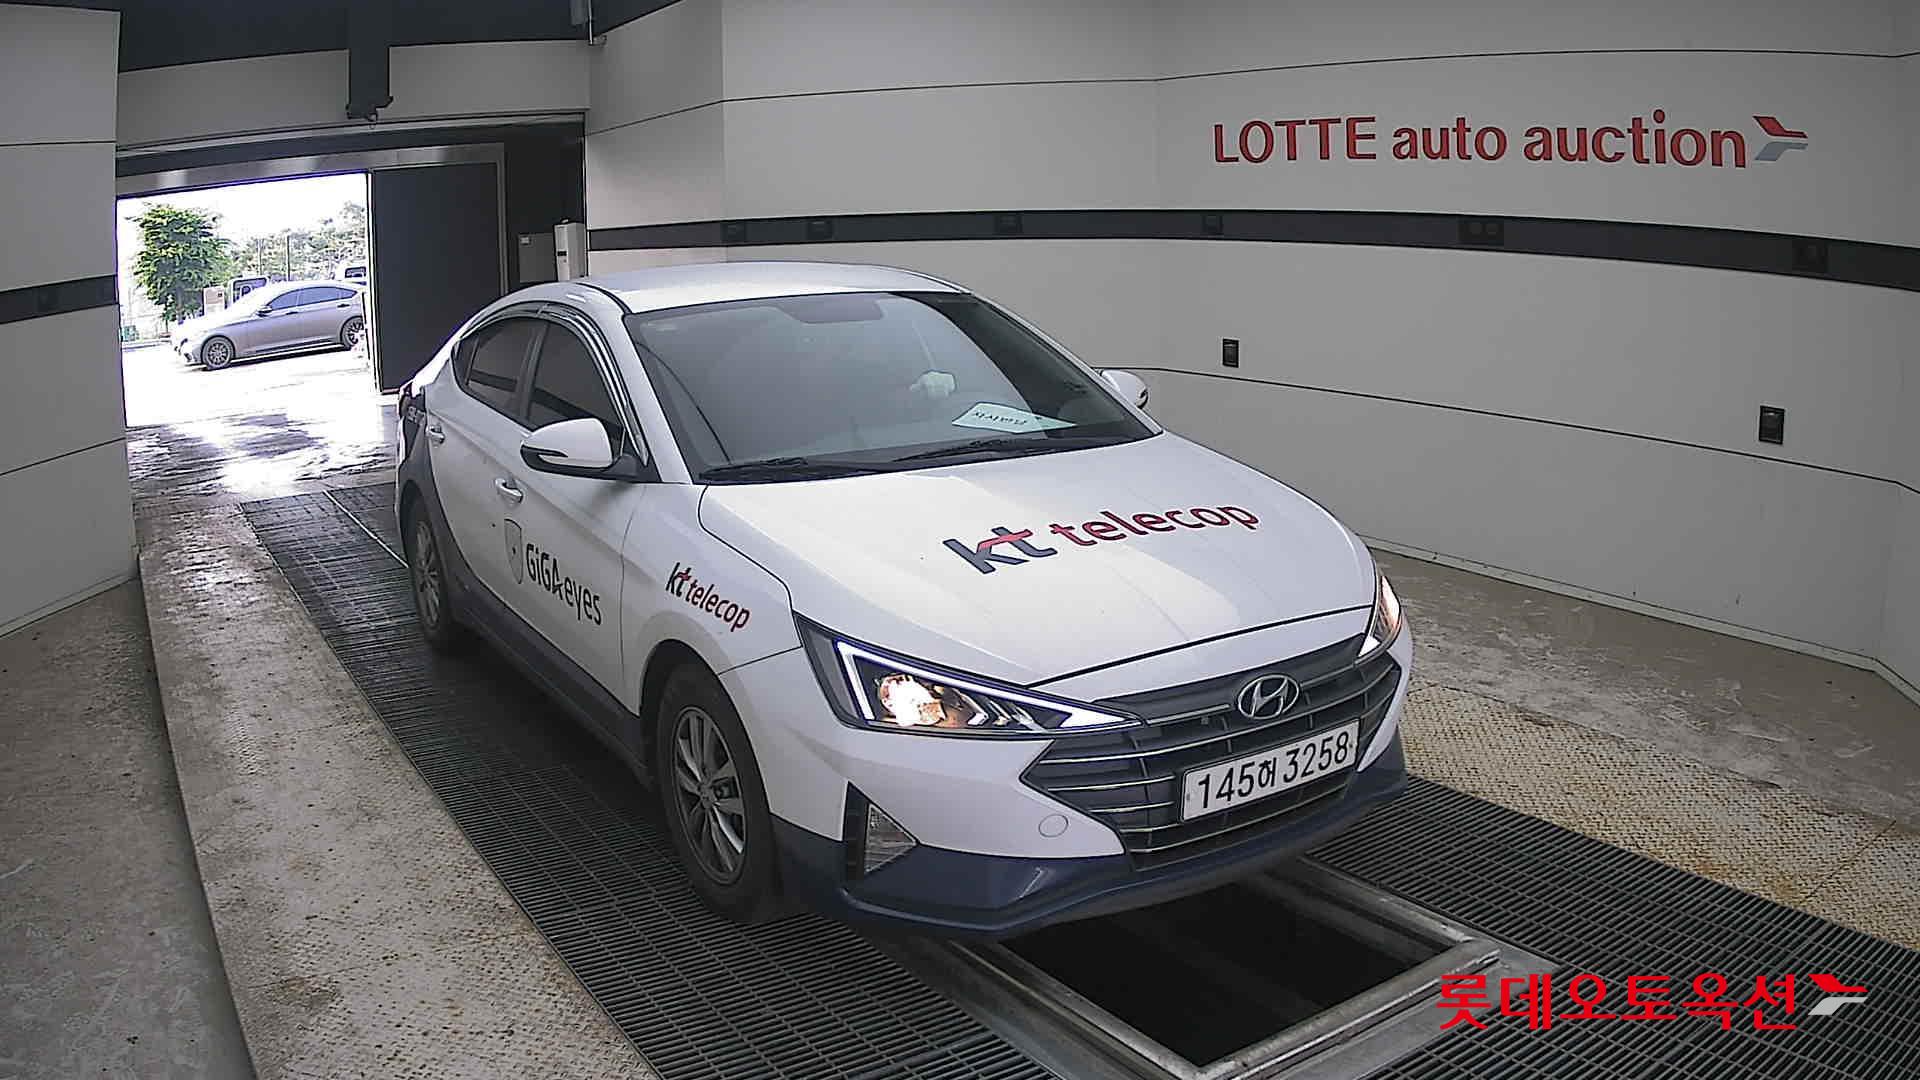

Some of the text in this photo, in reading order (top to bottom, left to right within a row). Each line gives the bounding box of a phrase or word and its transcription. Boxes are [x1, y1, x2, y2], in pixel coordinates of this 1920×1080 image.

[1213, 109, 1747, 169] LOTTE auto auction
[943, 503, 1260, 575] kt telecop
[665, 562, 751, 632] kt telecop
[1283, 731, 1349, 783] 3258
